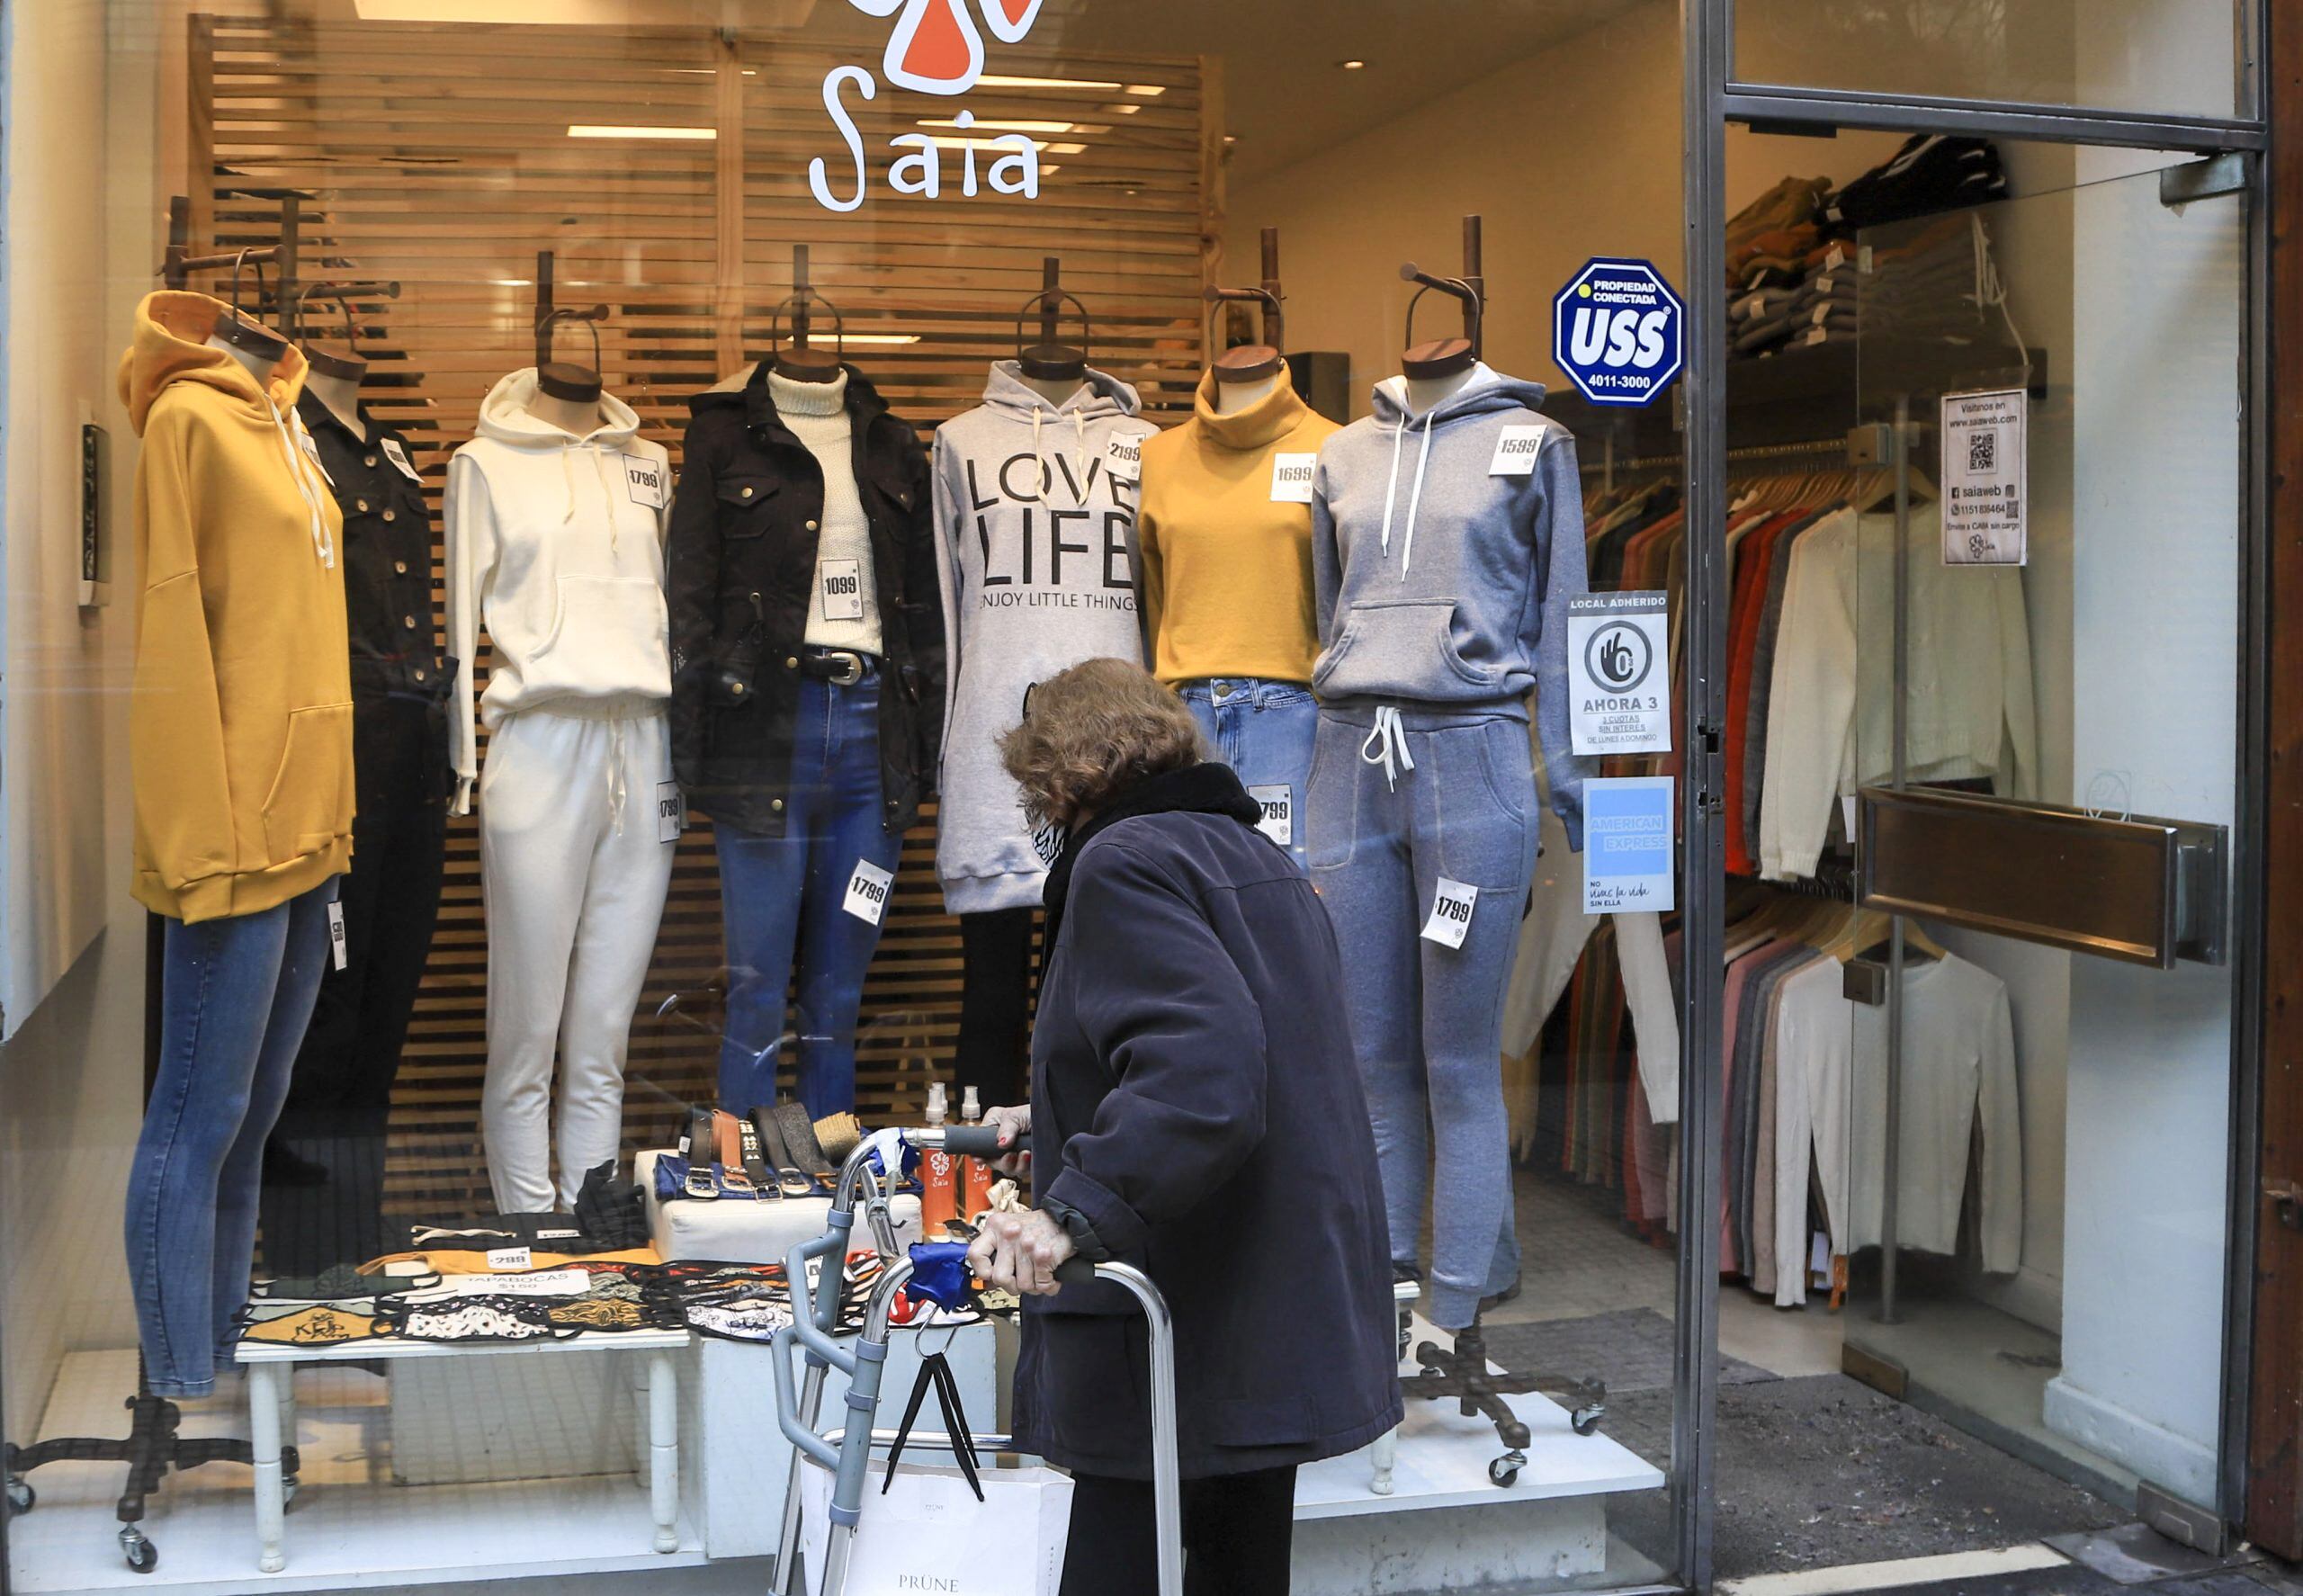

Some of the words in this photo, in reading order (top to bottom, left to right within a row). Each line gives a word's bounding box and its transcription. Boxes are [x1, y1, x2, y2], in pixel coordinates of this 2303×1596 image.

[809, 66, 1039, 212] Saia
[1593, 280, 1656, 293] PROPIEDAD
[1593, 292, 1657, 305] CONECTADA
[1571, 308, 1668, 369] USS
[1589, 374, 1651, 389] 4011-3000
[1995, 402, 2005, 411] en
[1110, 443, 1140, 462] 2199
[1501, 438, 1537, 453] 1599
[630, 470, 658, 488] 1799
[1278, 466, 1312, 481] 1699
[1963, 485, 2001, 498] saiaweb
[826, 577, 856, 595] 1099
[980, 592, 1024, 609] NJOY
[1030, 593, 1078, 607] LITTLE
[1571, 599, 1606, 609] LOCAL
[1609, 596, 1666, 608] ADHERIDO
[1583, 698, 1642, 712] AHORA
[1648, 697, 1658, 709] 3
[1609, 715, 1640, 724] CUOTAS
[1599, 725, 1611, 733] SIN
[1599, 735, 1618, 743] LUNES
[1626, 734, 1657, 742] DOMINGO
[1260, 802, 1288, 820] 799
[1591, 817, 1662, 830] AMERICAN
[1606, 836, 1667, 849] EXPRESS
[853, 876, 885, 903] 1799
[1616, 885, 1626, 898] la
[1629, 883, 1649, 897] vida
[1437, 896, 1470, 922] 1799
[932, 1177, 948, 1188] Saia
[900, 1574, 959, 1592] PRÜNE
